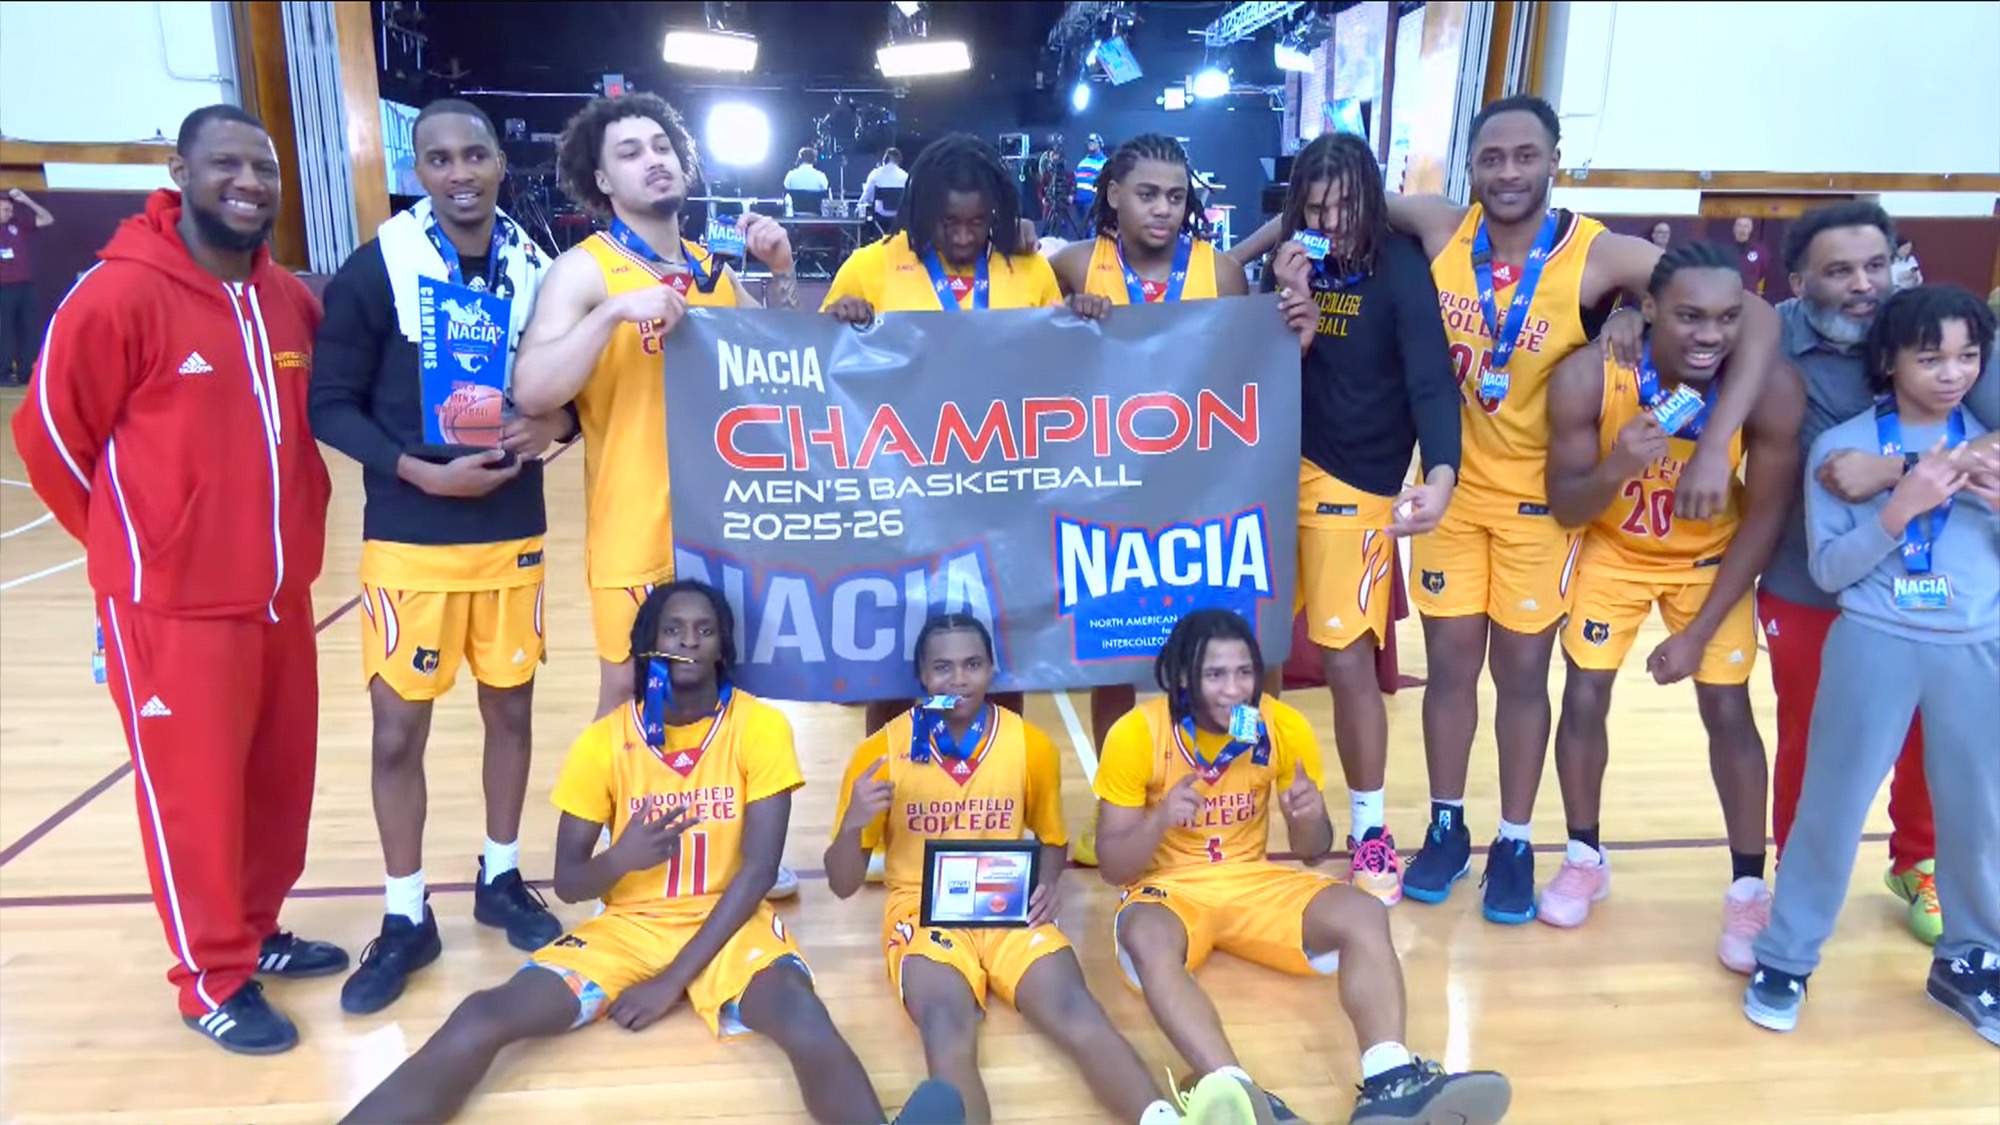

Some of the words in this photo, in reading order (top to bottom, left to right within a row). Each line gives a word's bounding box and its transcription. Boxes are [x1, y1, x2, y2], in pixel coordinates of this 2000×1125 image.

[1321, 291, 1362, 316] COLLEGE
[420, 286, 438, 370] CHAMPIONS
[447, 319, 497, 345] NACIA
[717, 338, 825, 394] NACIA
[1482, 370, 1510, 389] NACIA
[714, 383, 1260, 472] CHAMPION
[723, 478, 861, 503] MEN'S
[868, 464, 1143, 500] BASKETBALL
[1622, 479, 1676, 538] 20
[723, 509, 904, 541] 2025-26
[1061, 513, 1270, 607] NACIA
[1893, 577, 1949, 597] NACIA
[675, 547, 1001, 680] NACIA
[1090, 617, 1124, 629] NORTH
[1126, 613, 1178, 626] AMERICAN
[906, 799, 1014, 816] BLOOMFIELD
[908, 812, 1012, 834] COLLEGE
